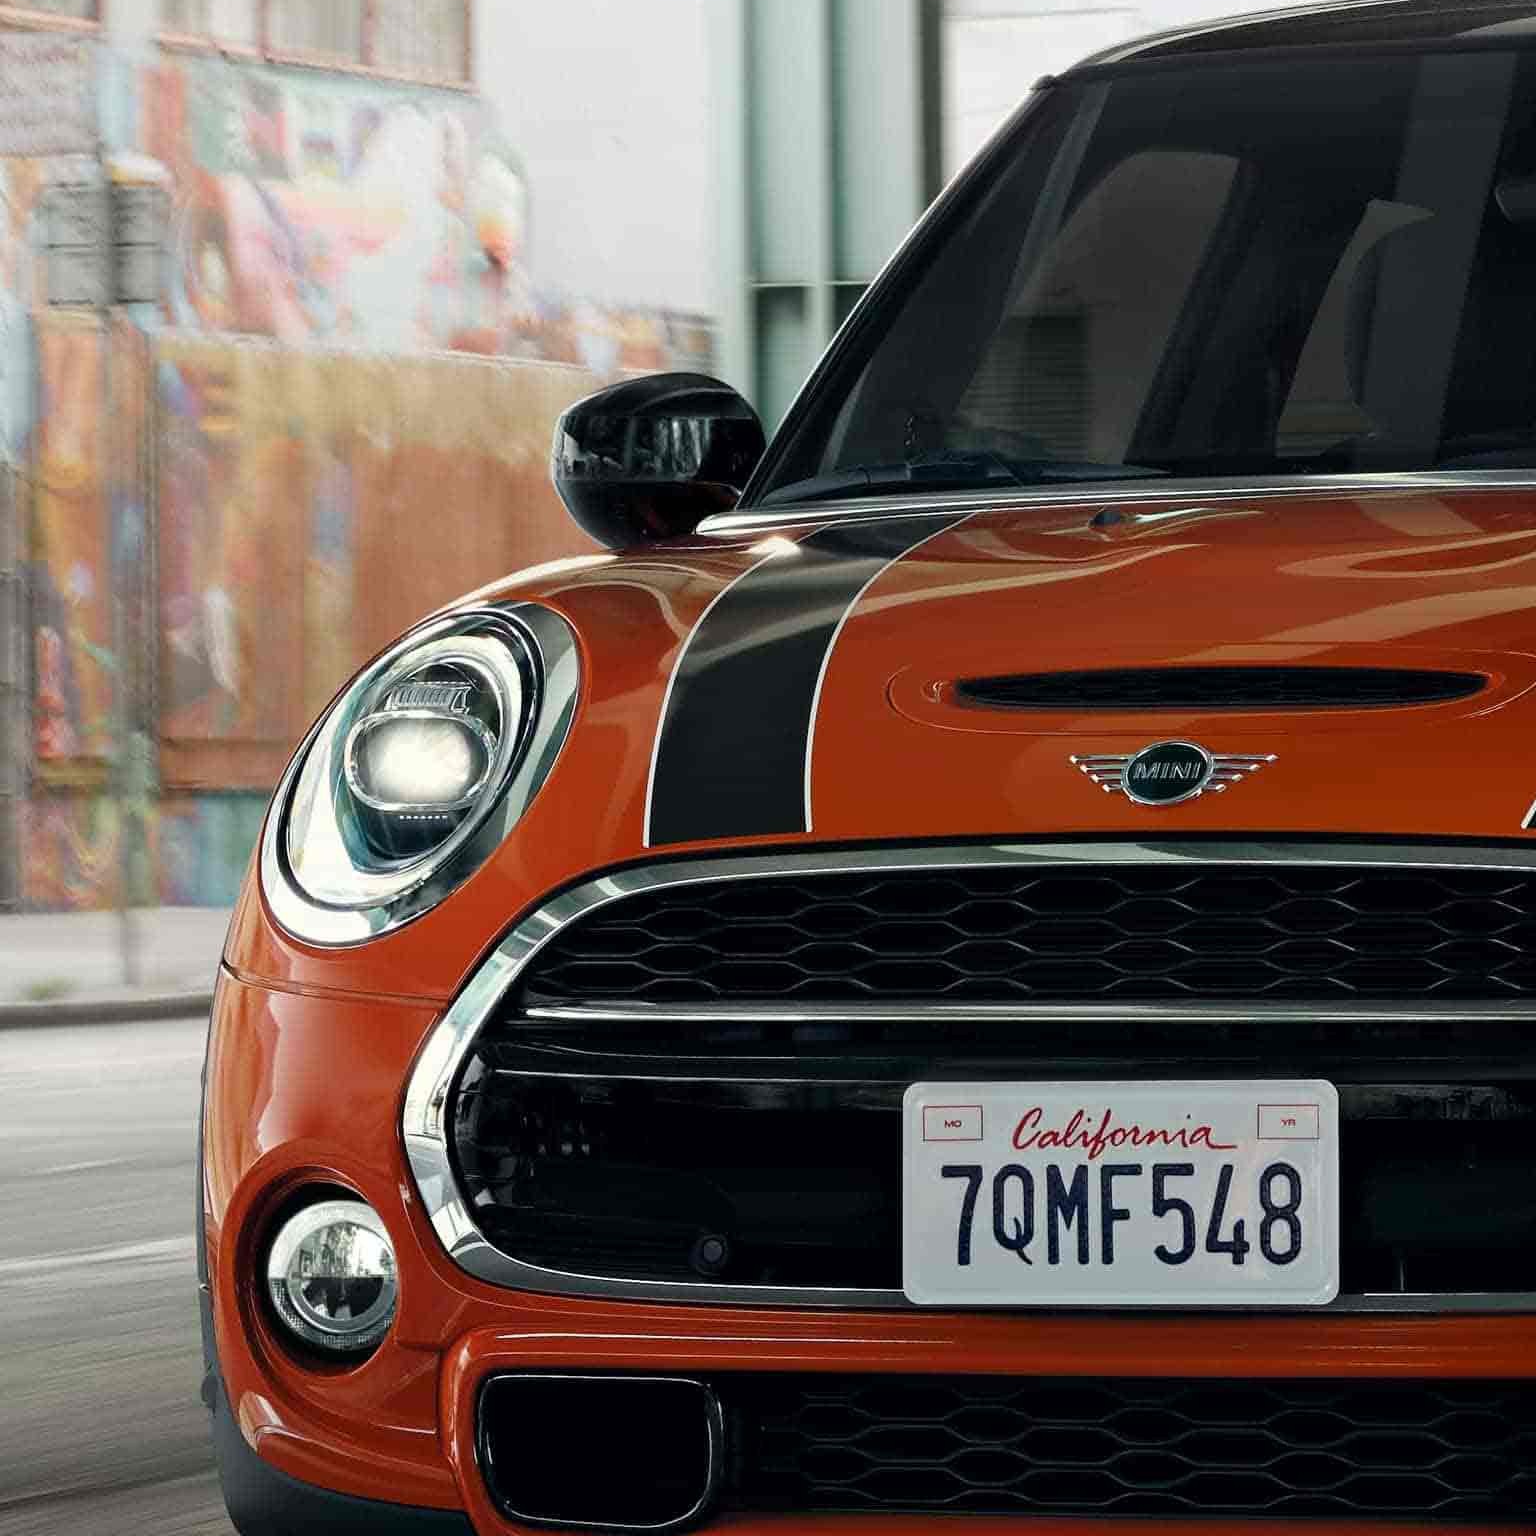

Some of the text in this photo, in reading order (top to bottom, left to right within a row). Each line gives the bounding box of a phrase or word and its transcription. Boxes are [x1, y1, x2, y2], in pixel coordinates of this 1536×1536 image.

[1133, 761, 1201, 779] MINI
[944, 1119, 962, 1128] MO
[1281, 1118, 1297, 1127] YR
[1012, 1107, 1238, 1160] California
[941, 1162, 1303, 1266] 7QMF548
